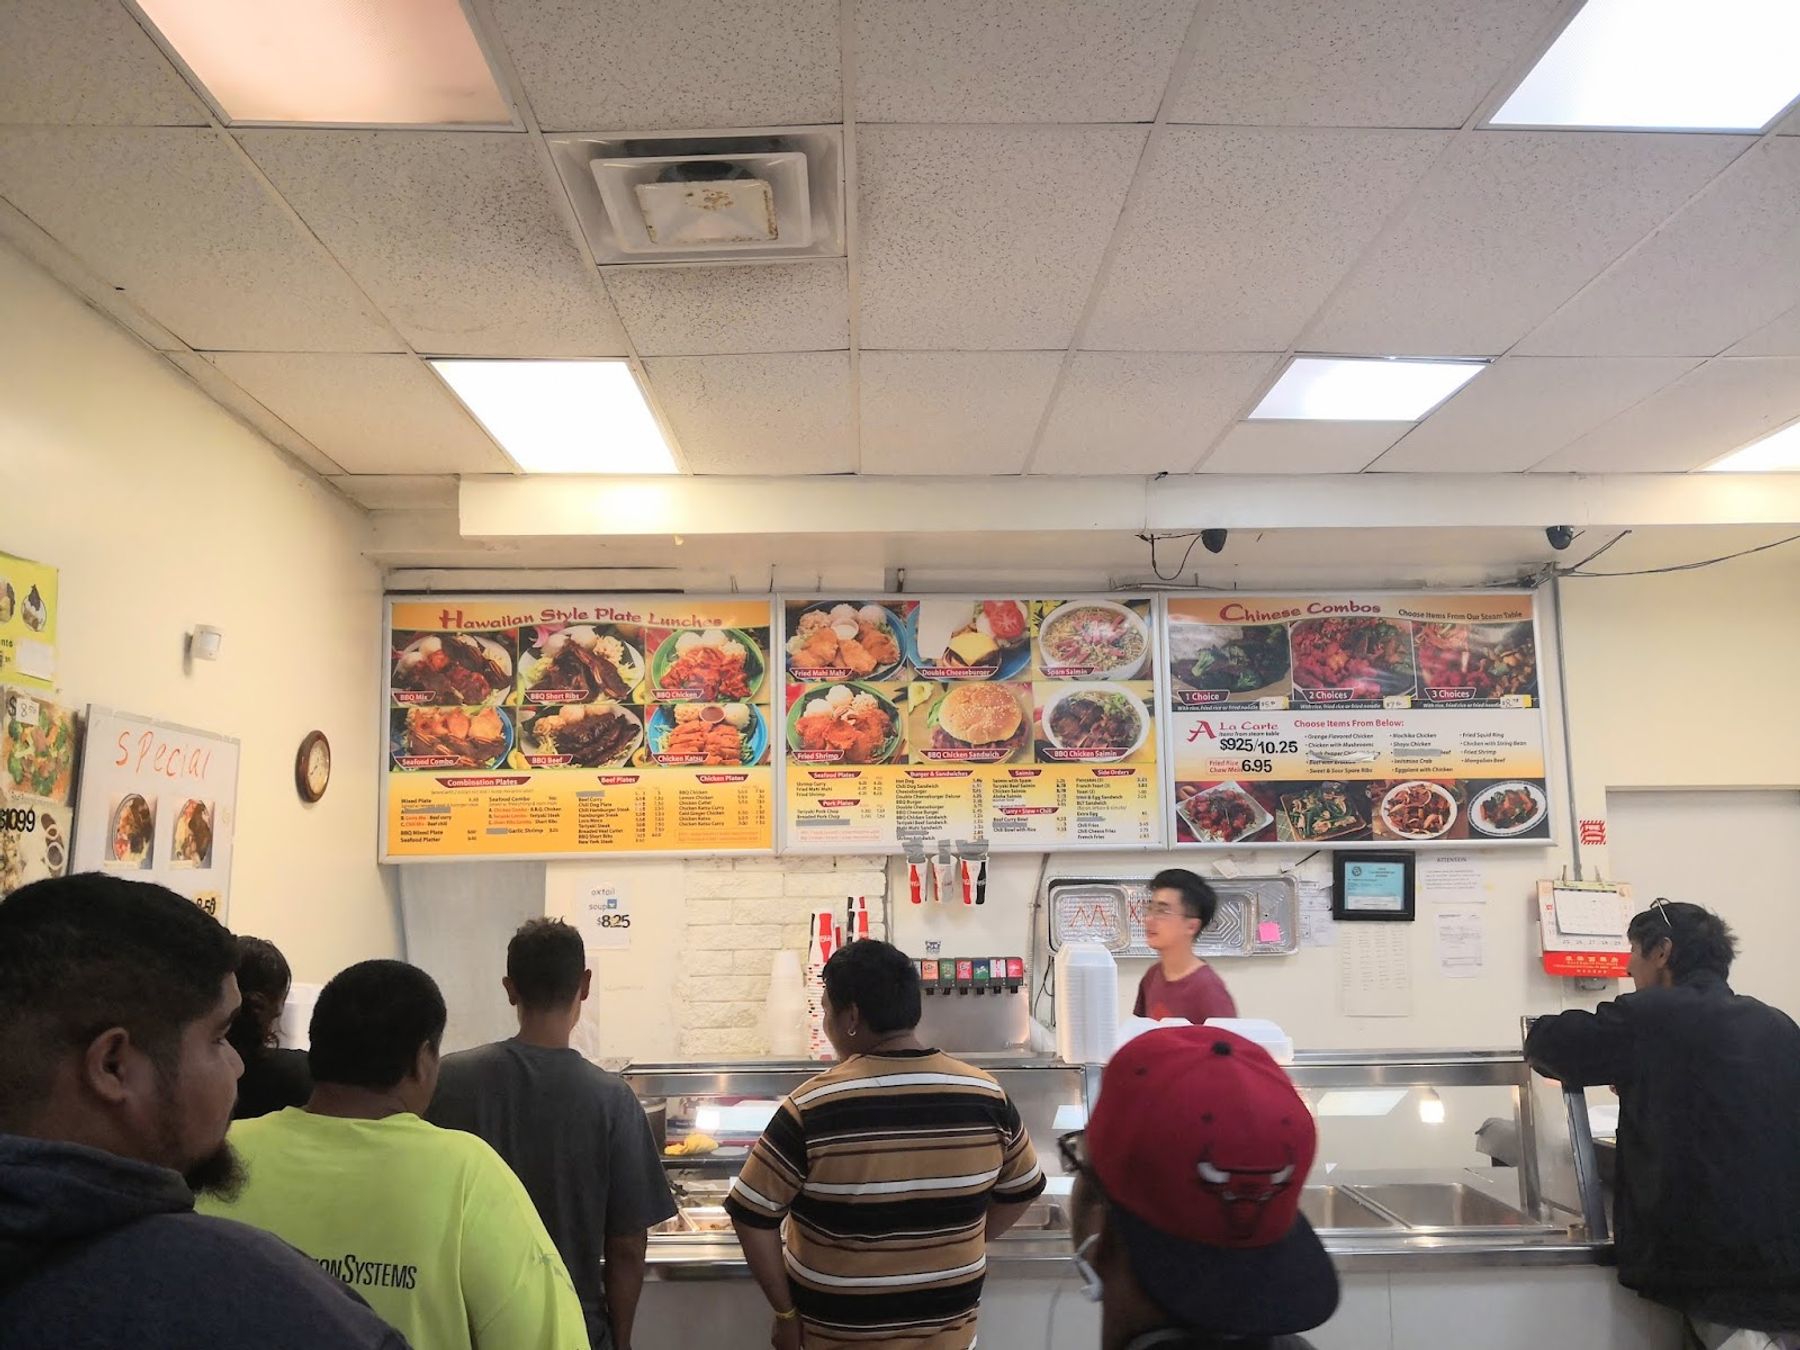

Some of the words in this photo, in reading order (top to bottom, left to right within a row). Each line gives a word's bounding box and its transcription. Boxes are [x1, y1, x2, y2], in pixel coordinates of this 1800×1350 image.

[1220, 604, 1301, 622] Chinese
[1307, 600, 1381, 614] Combos
[1398, 609, 1425, 618] Choose
[439, 609, 534, 629] Hawaiian
[540, 607, 588, 623] Style
[594, 608, 642, 623] Plate
[656, 691, 670, 699] BBQ
[671, 691, 697, 699] Chicken
[1192, 692, 1220, 700] Choice
[1316, 691, 1348, 699] Choices
[1432, 690, 1437, 698] 3
[1438, 690, 1470, 698] Choices
[1187, 720, 1216, 742] A
[1220, 722, 1236, 730] La
[1241, 721, 1278, 730] Carte
[1242, 759, 1272, 772] 6.95
[588, 904, 607, 912] soup
